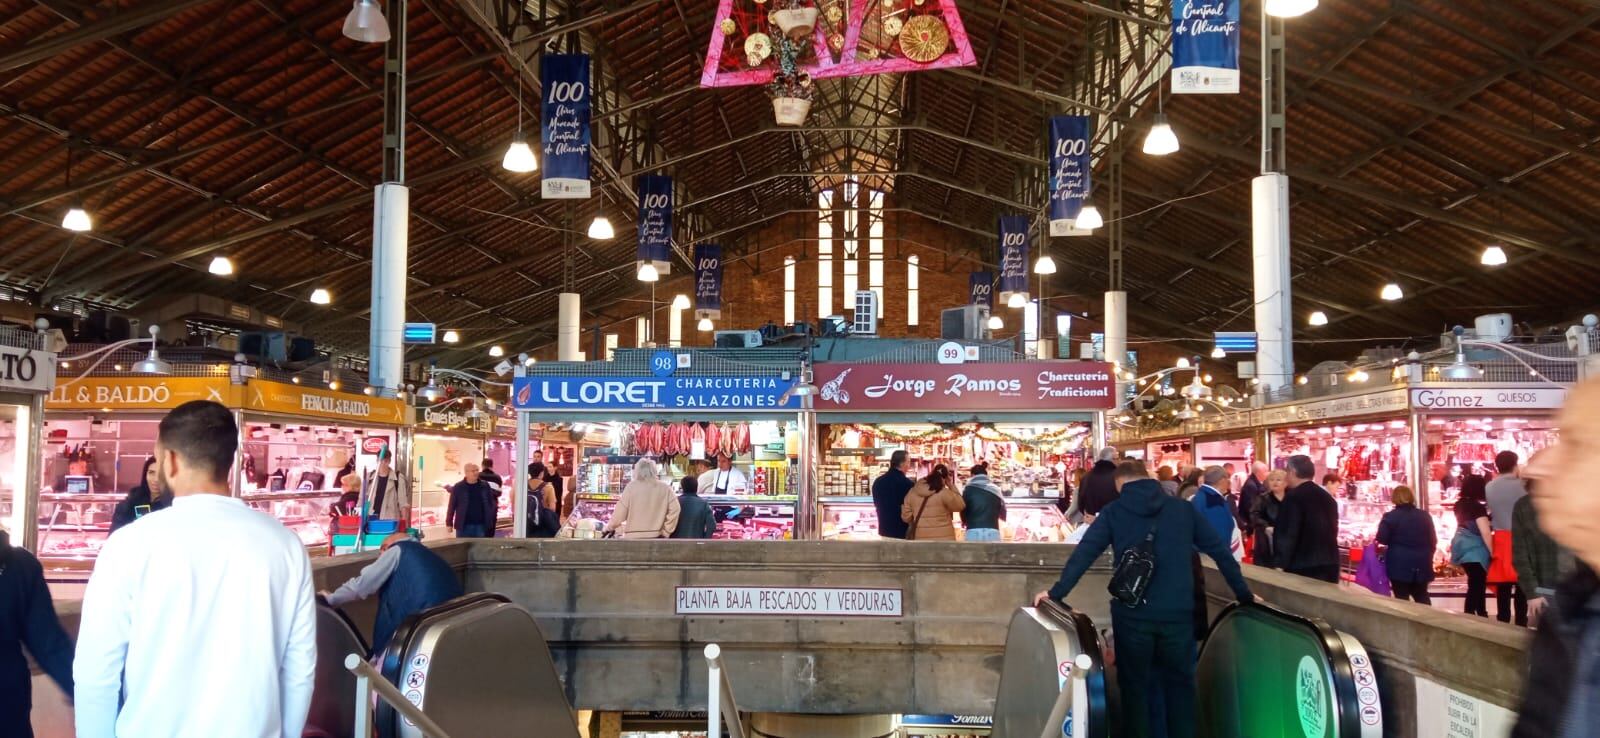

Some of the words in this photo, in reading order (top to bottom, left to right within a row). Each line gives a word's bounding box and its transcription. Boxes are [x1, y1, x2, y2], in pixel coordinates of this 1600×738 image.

[1182, 2, 1224, 19] Central
[1176, 20, 1188, 35] de
[1191, 19, 1236, 36] Alicante
[548, 80, 585, 104] 100
[548, 117, 580, 132] Mercado
[549, 130, 580, 143] Central
[544, 144, 553, 155] de
[555, 143, 587, 156] Alicante
[1055, 138, 1086, 158] 100
[643, 193, 668, 209] 100
[1002, 232, 1025, 247] 100
[698, 257, 718, 270] 100
[972, 284, 990, 295] 100
[944, 349, 958, 358] 99
[0, 350, 36, 381] TÓ
[654, 358, 672, 371] 98
[676, 378, 776, 388] CHARCUTERIA
[864, 374, 936, 398] Jorge
[944, 373, 1021, 398] Ramos
[76, 385, 91, 403] &
[96, 381, 170, 404] BALDÓ
[542, 381, 666, 404] LLORET
[1038, 386, 1108, 400] Tradicional
[1418, 390, 1484, 407] Gómez
[1497, 392, 1537, 403] QUESOS
[676, 395, 776, 407] SALAZONES
[679, 590, 719, 609] PLANTA
[726, 590, 752, 609] BAJA
[759, 590, 817, 610] PESCADOS
[823, 591, 831, 610] Y
[837, 591, 894, 611] VERDURAS
